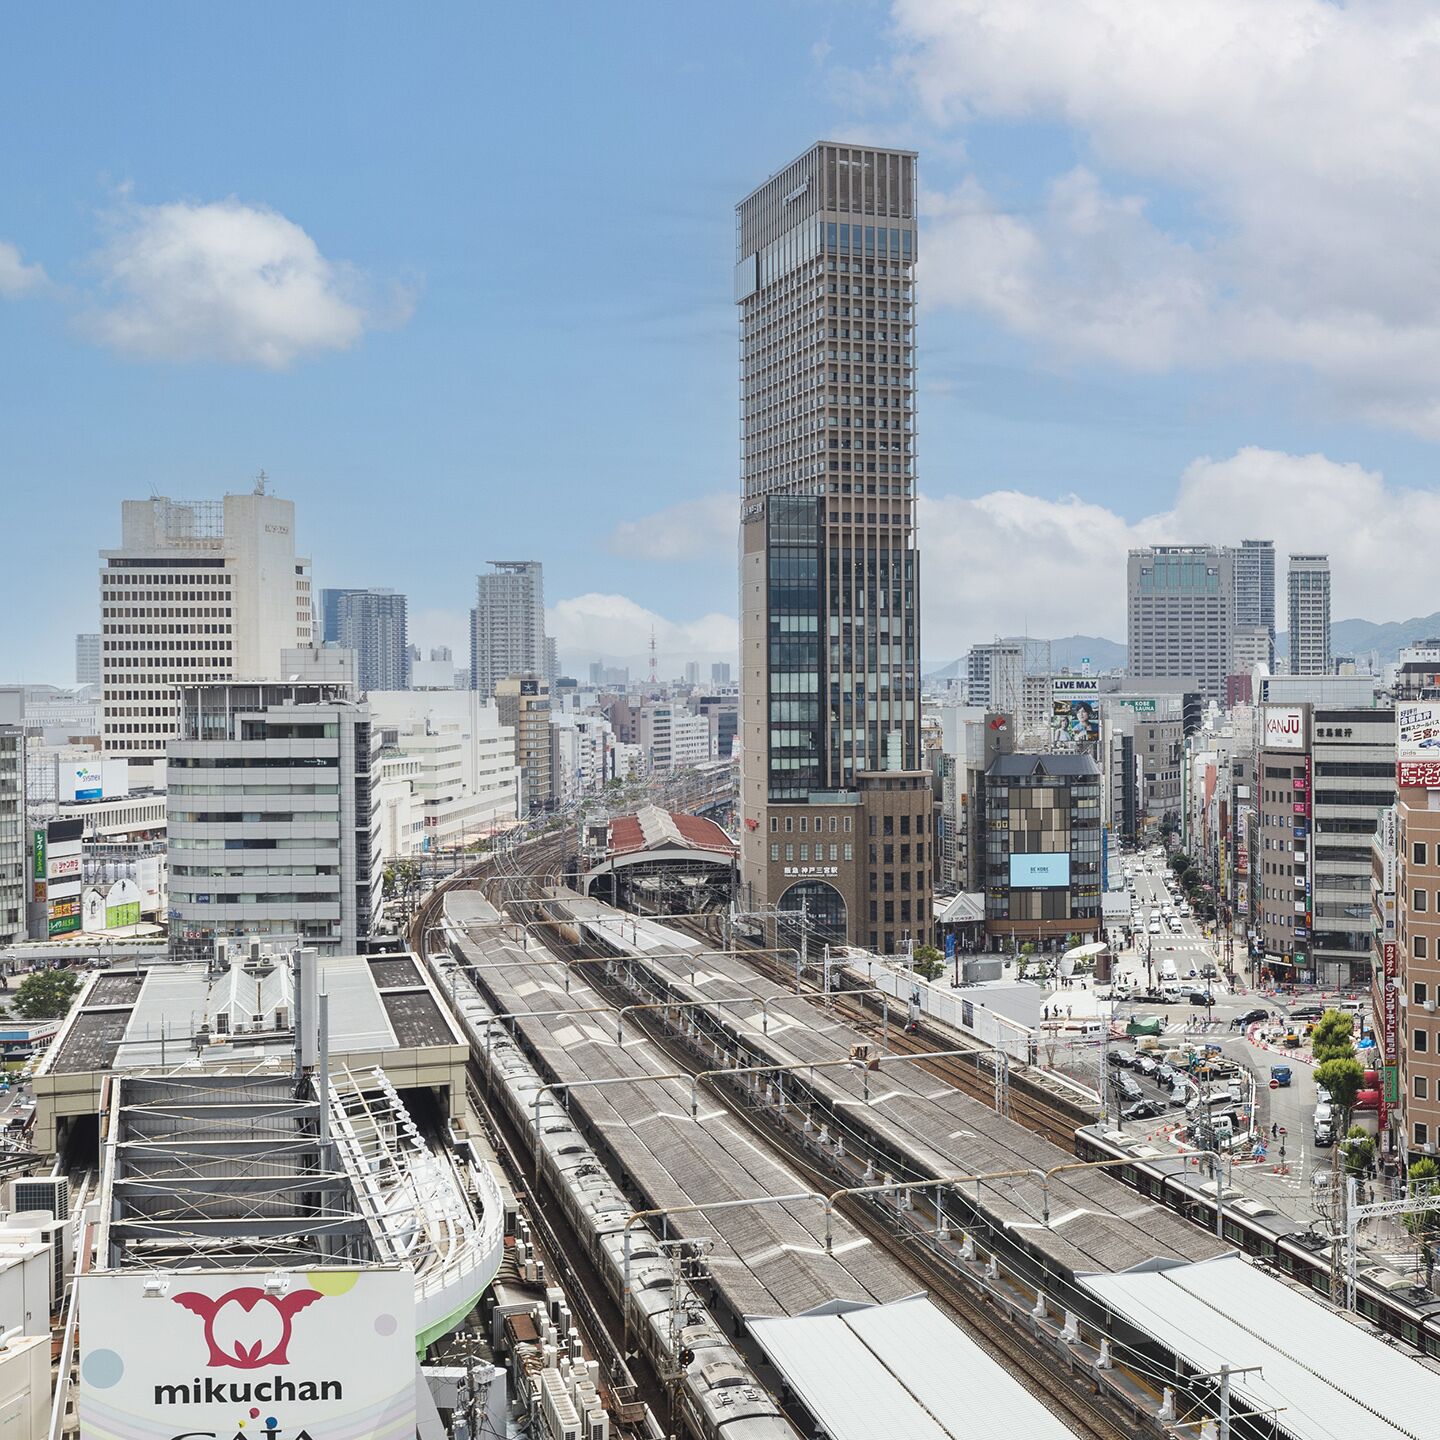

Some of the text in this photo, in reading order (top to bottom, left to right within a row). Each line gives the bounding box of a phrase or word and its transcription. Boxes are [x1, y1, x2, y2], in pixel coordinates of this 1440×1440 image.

[1076, 681, 1097, 689] MAX
[1386, 945, 1395, 974] カラオケ
[154, 1375, 343, 1405] mikuchan
